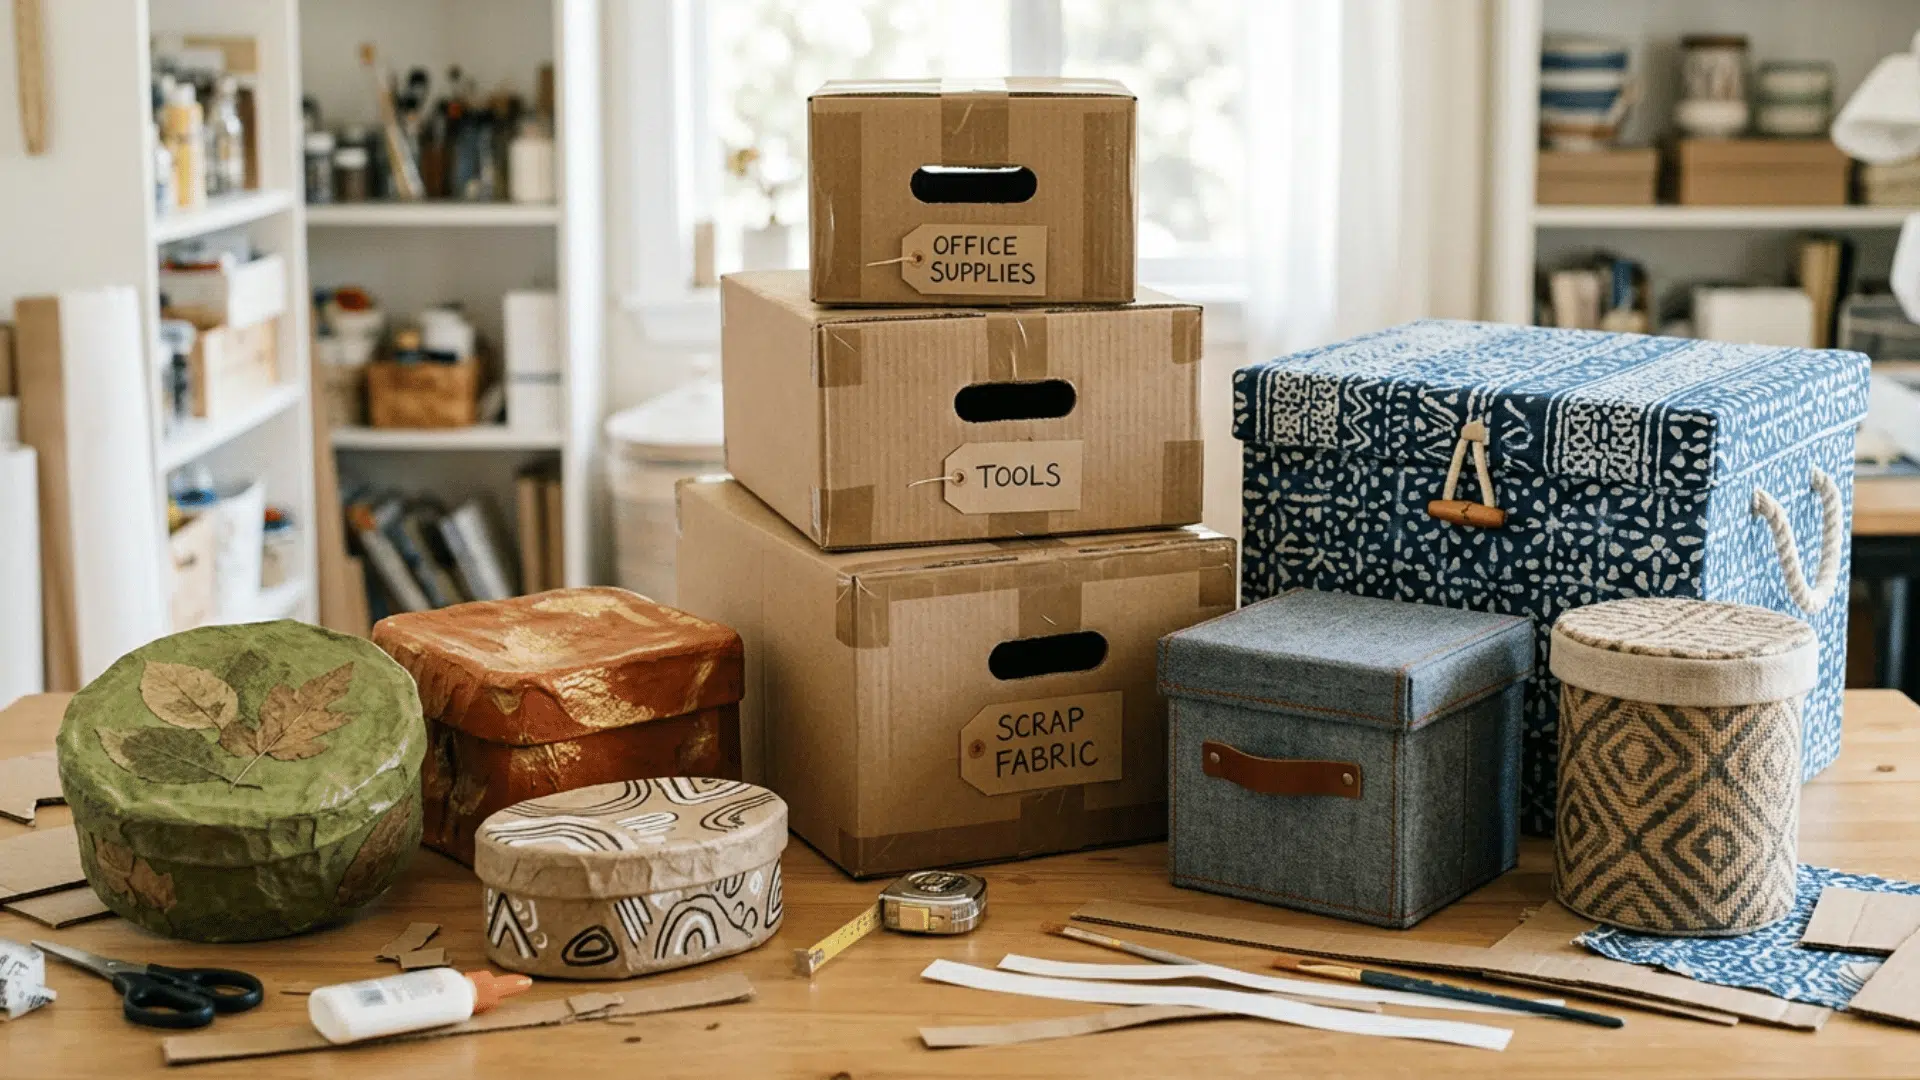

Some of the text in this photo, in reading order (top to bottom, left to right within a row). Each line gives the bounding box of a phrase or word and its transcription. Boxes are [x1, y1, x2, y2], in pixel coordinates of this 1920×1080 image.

[933, 235, 1017, 256] OFFICE
[930, 261, 1036, 285] SUPPLIES
[975, 463, 1061, 489] TOOLS
[996, 707, 1084, 741] SCRAP
[996, 740, 1099, 778] FABRIC
